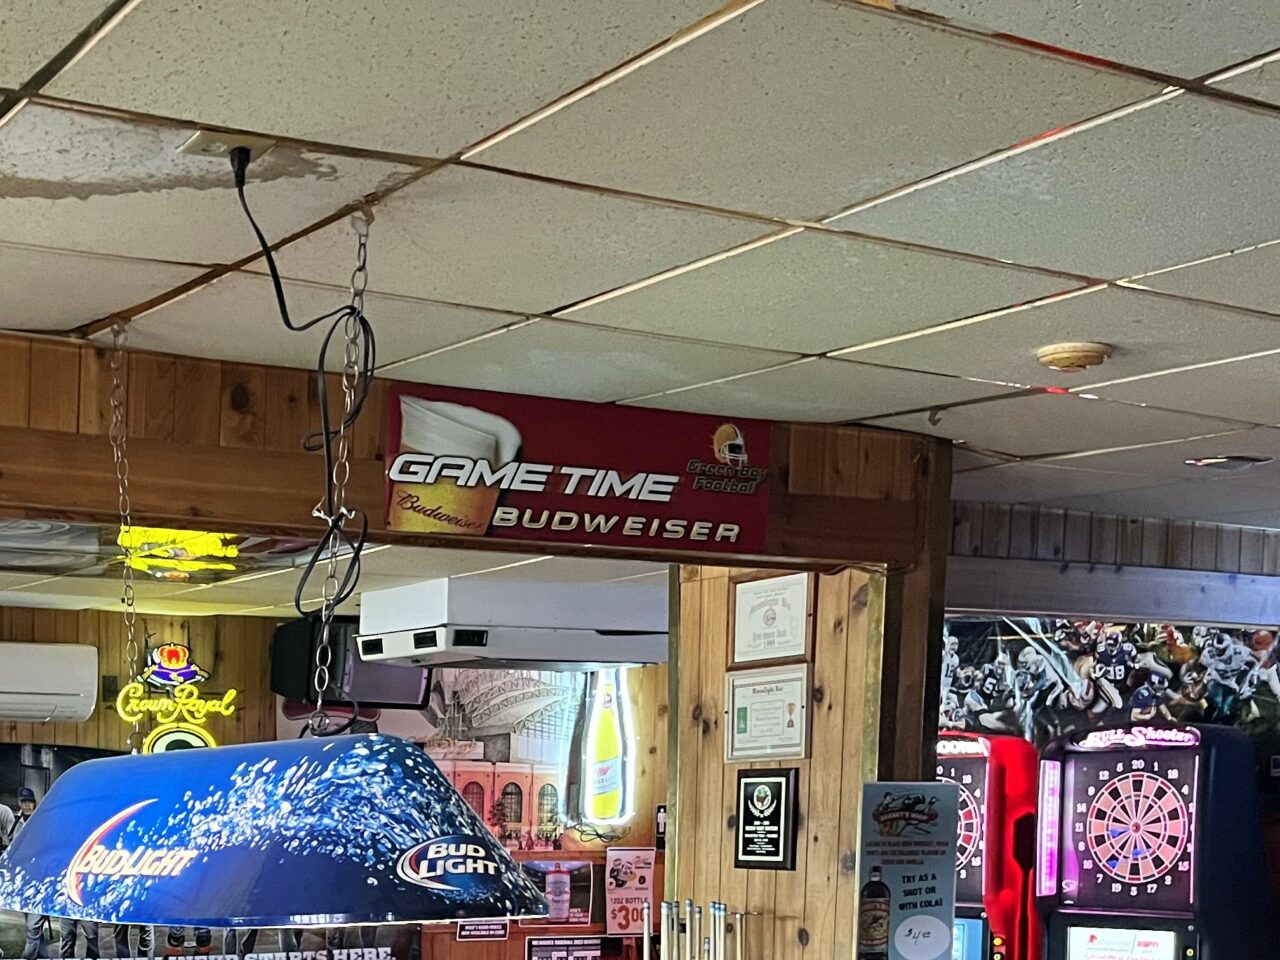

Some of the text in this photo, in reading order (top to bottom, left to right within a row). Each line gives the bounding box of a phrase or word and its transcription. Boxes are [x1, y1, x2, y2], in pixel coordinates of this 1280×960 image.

[686, 459, 736, 477] Green
[389, 453, 679, 501] GAME TIME
[397, 489, 483, 529] Budweiser
[492, 507, 740, 543] BUDWEISER
[116, 682, 237, 724] Crown Royal
[1131, 759, 1145, 769] 20
[1154, 762, 1159, 771] 1
[427, 843, 486, 859] BUD
[79, 845, 199, 876] BUD LIGHT
[419, 858, 498, 879] LIGHT
[902, 875, 915, 883] TRY
[919, 873, 928, 882] AS
[1096, 874, 1104, 883] 7
[903, 886, 936, 897] SHOT OR
[1146, 883, 1157, 894] 17
[899, 898, 943, 911] WITH COLA!
